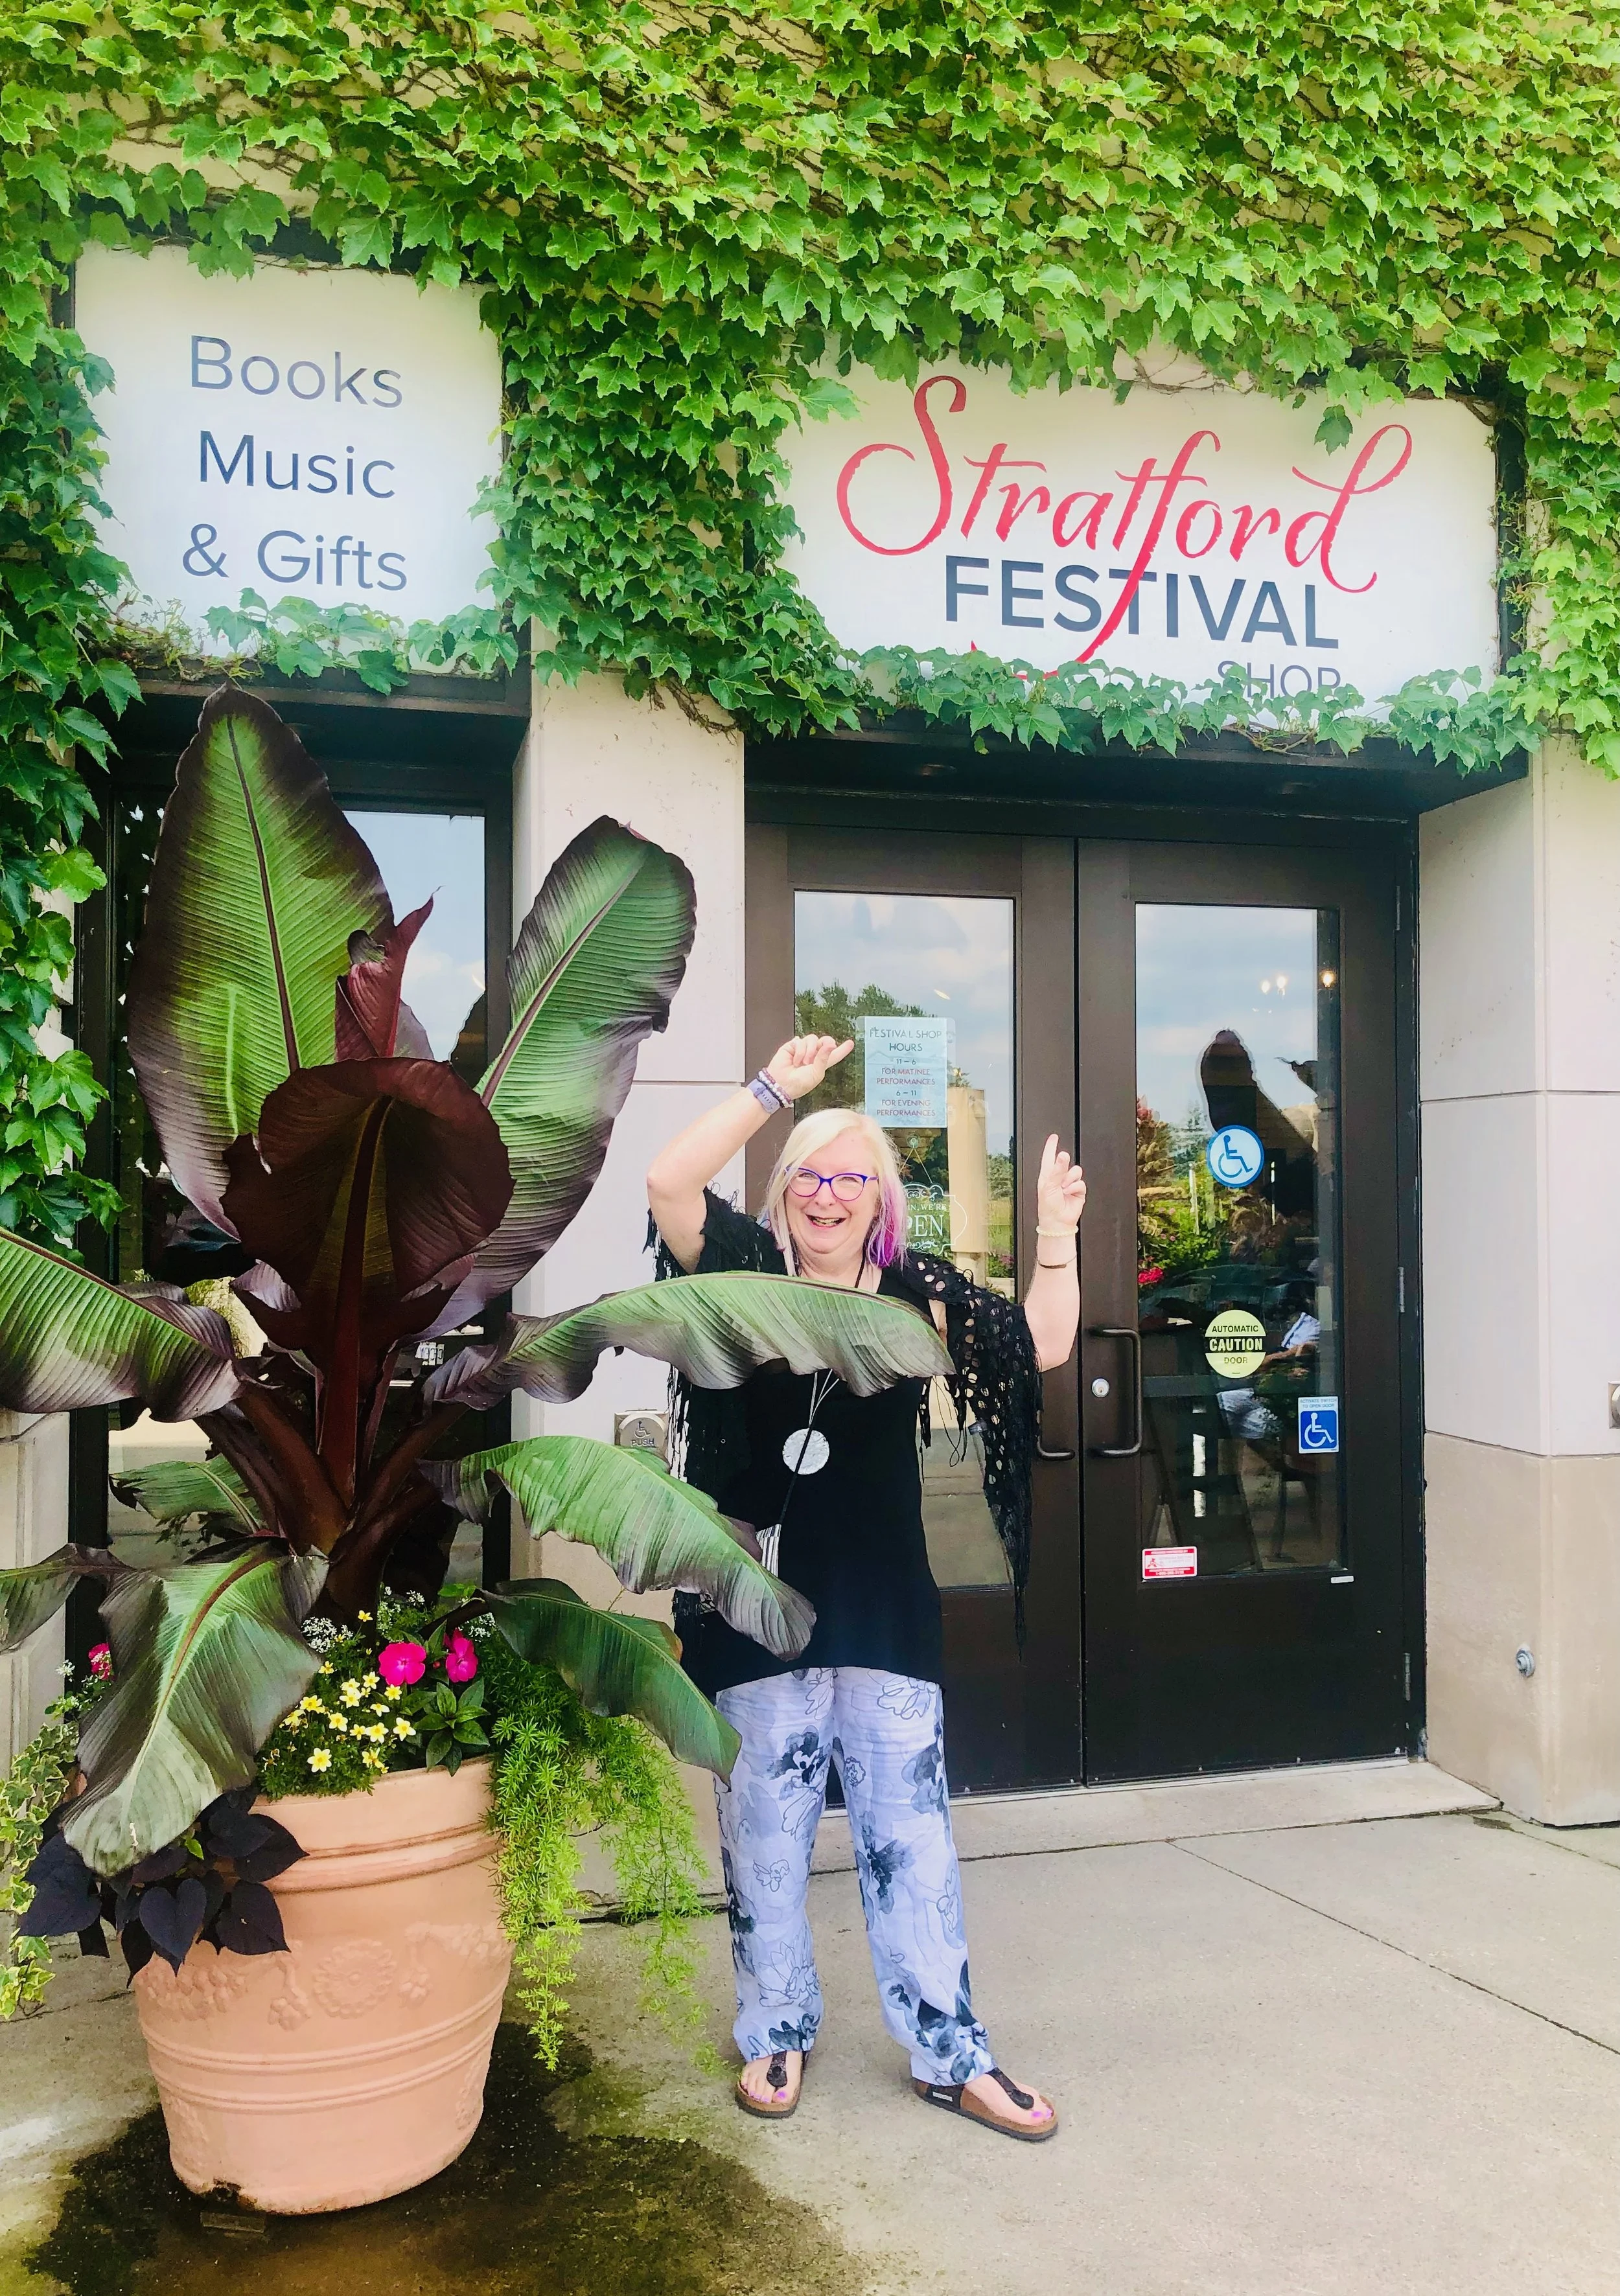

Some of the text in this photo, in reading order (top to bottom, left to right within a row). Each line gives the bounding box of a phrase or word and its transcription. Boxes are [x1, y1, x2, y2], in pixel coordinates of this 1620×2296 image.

[191, 334, 403, 408] Books
[200, 430, 396, 499] Music
[837, 375, 1413, 678] Stratford
[182, 523, 408, 591] & Gifts
[945, 555, 1339, 649] FESTIVAL
[870, 1029, 942, 1039] FESTIVAL SHOP
[889, 1042, 923, 1051] HOURS
[907, 1214, 944, 1237] EN
[1209, 1338, 1263, 1351] CAUTION
[631, 1438, 654, 1447] PUSH
